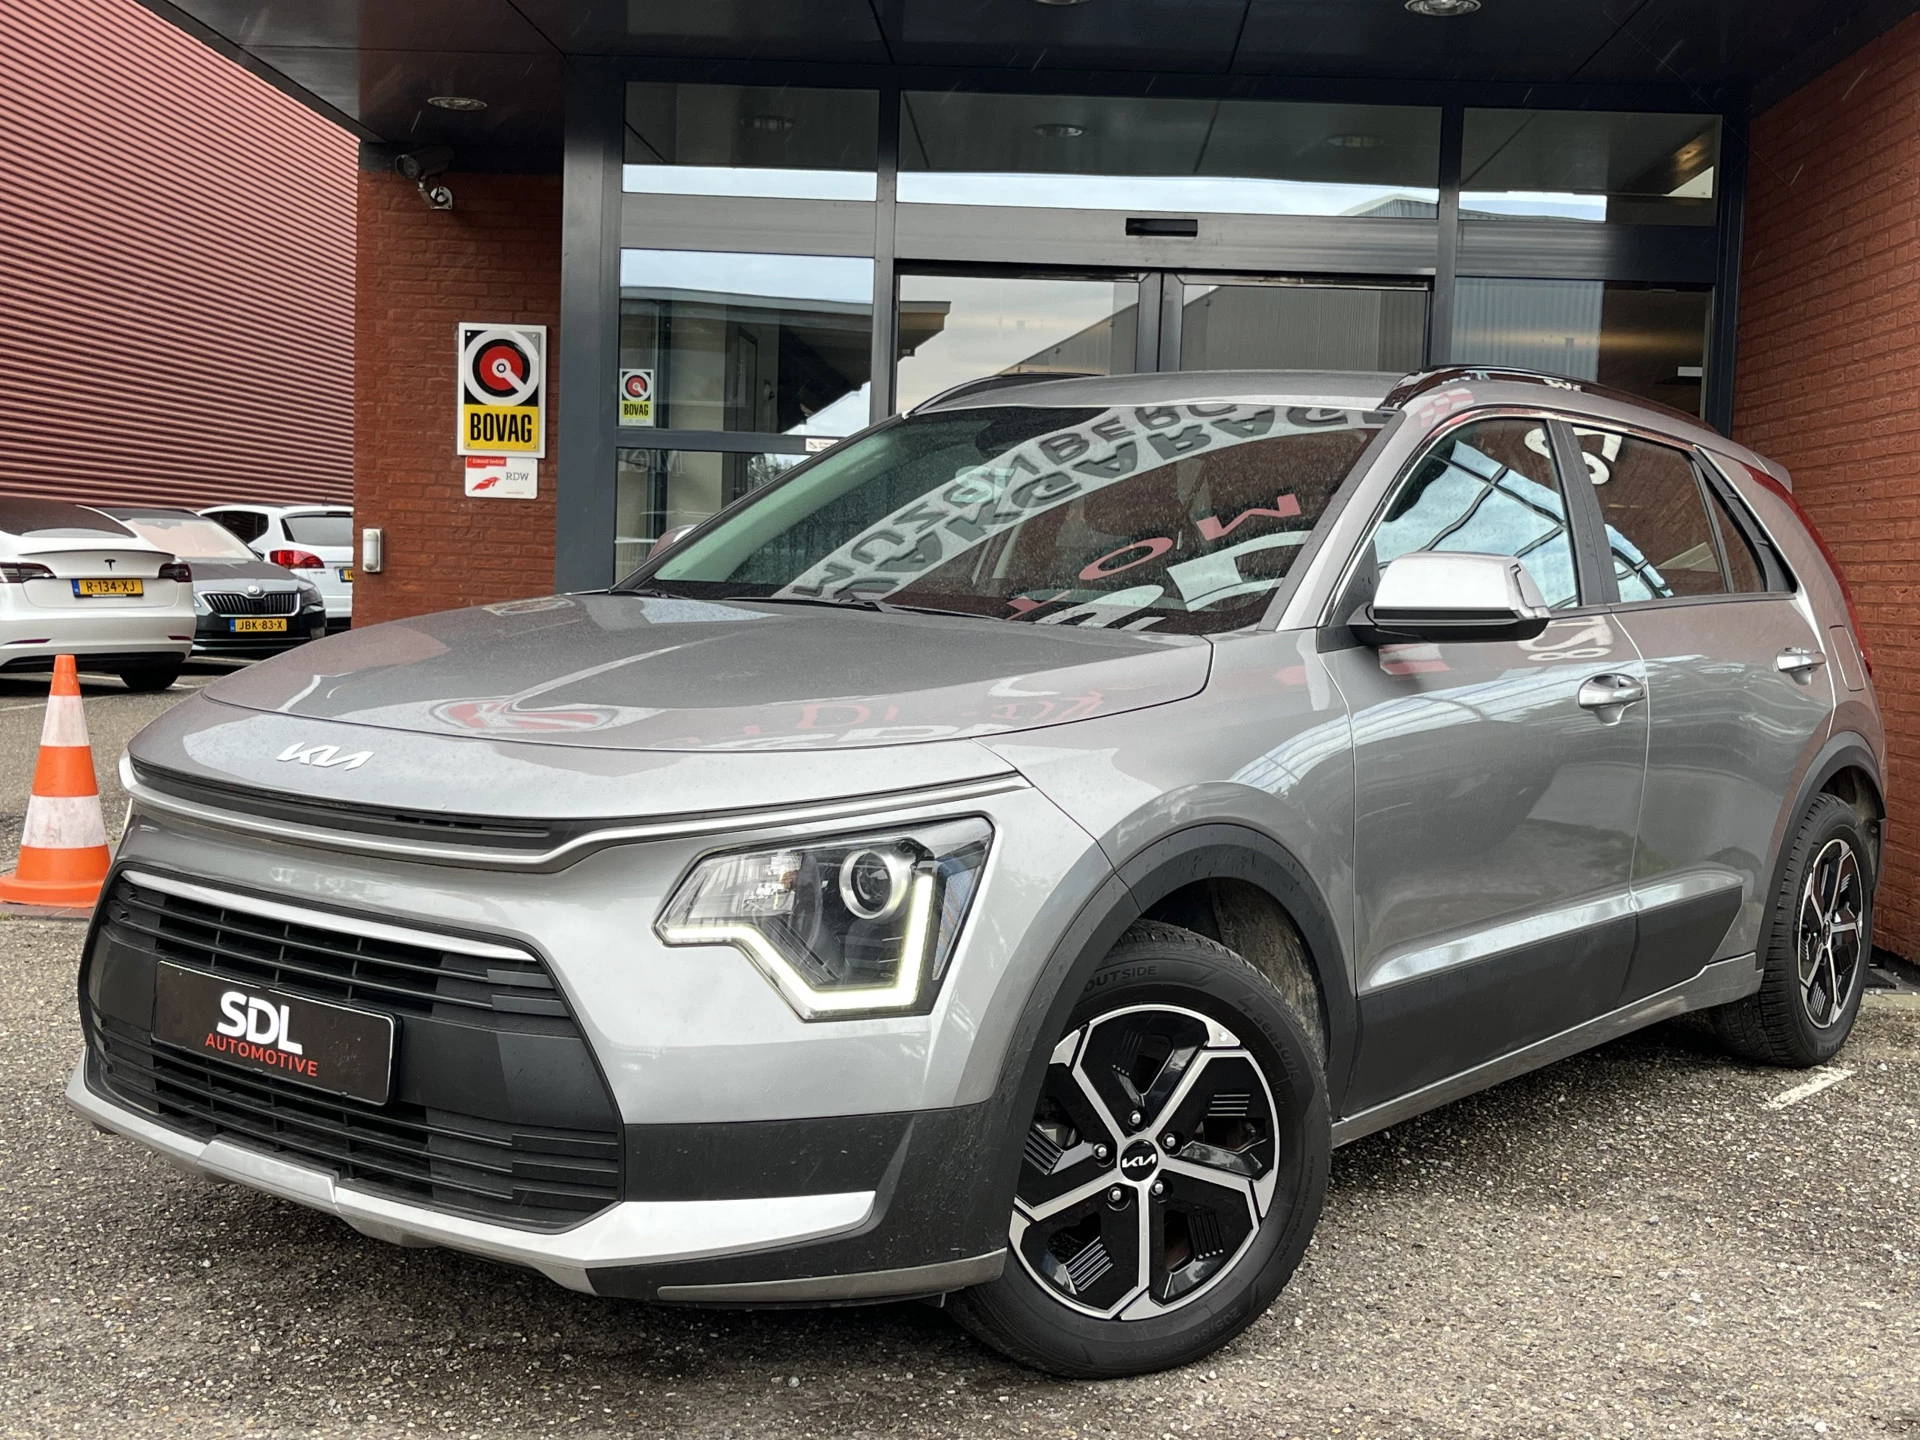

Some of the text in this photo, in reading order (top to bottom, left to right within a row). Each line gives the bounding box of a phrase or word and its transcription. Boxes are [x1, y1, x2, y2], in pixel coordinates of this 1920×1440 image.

[624, 403, 649, 416] BOVAG
[470, 412, 532, 443] BOVAG
[505, 471, 529, 481] RDW
[86, 580, 135, 593] R-134-XJ
[239, 620, 283, 631] JBK-83-X
[275, 741, 375, 772] KIA
[1083, 965, 1157, 992] OUTSIDE
[216, 991, 303, 1055] SDL
[205, 1032, 319, 1077] AUTOMOTIVE
[1121, 1153, 1157, 1168] KIA
